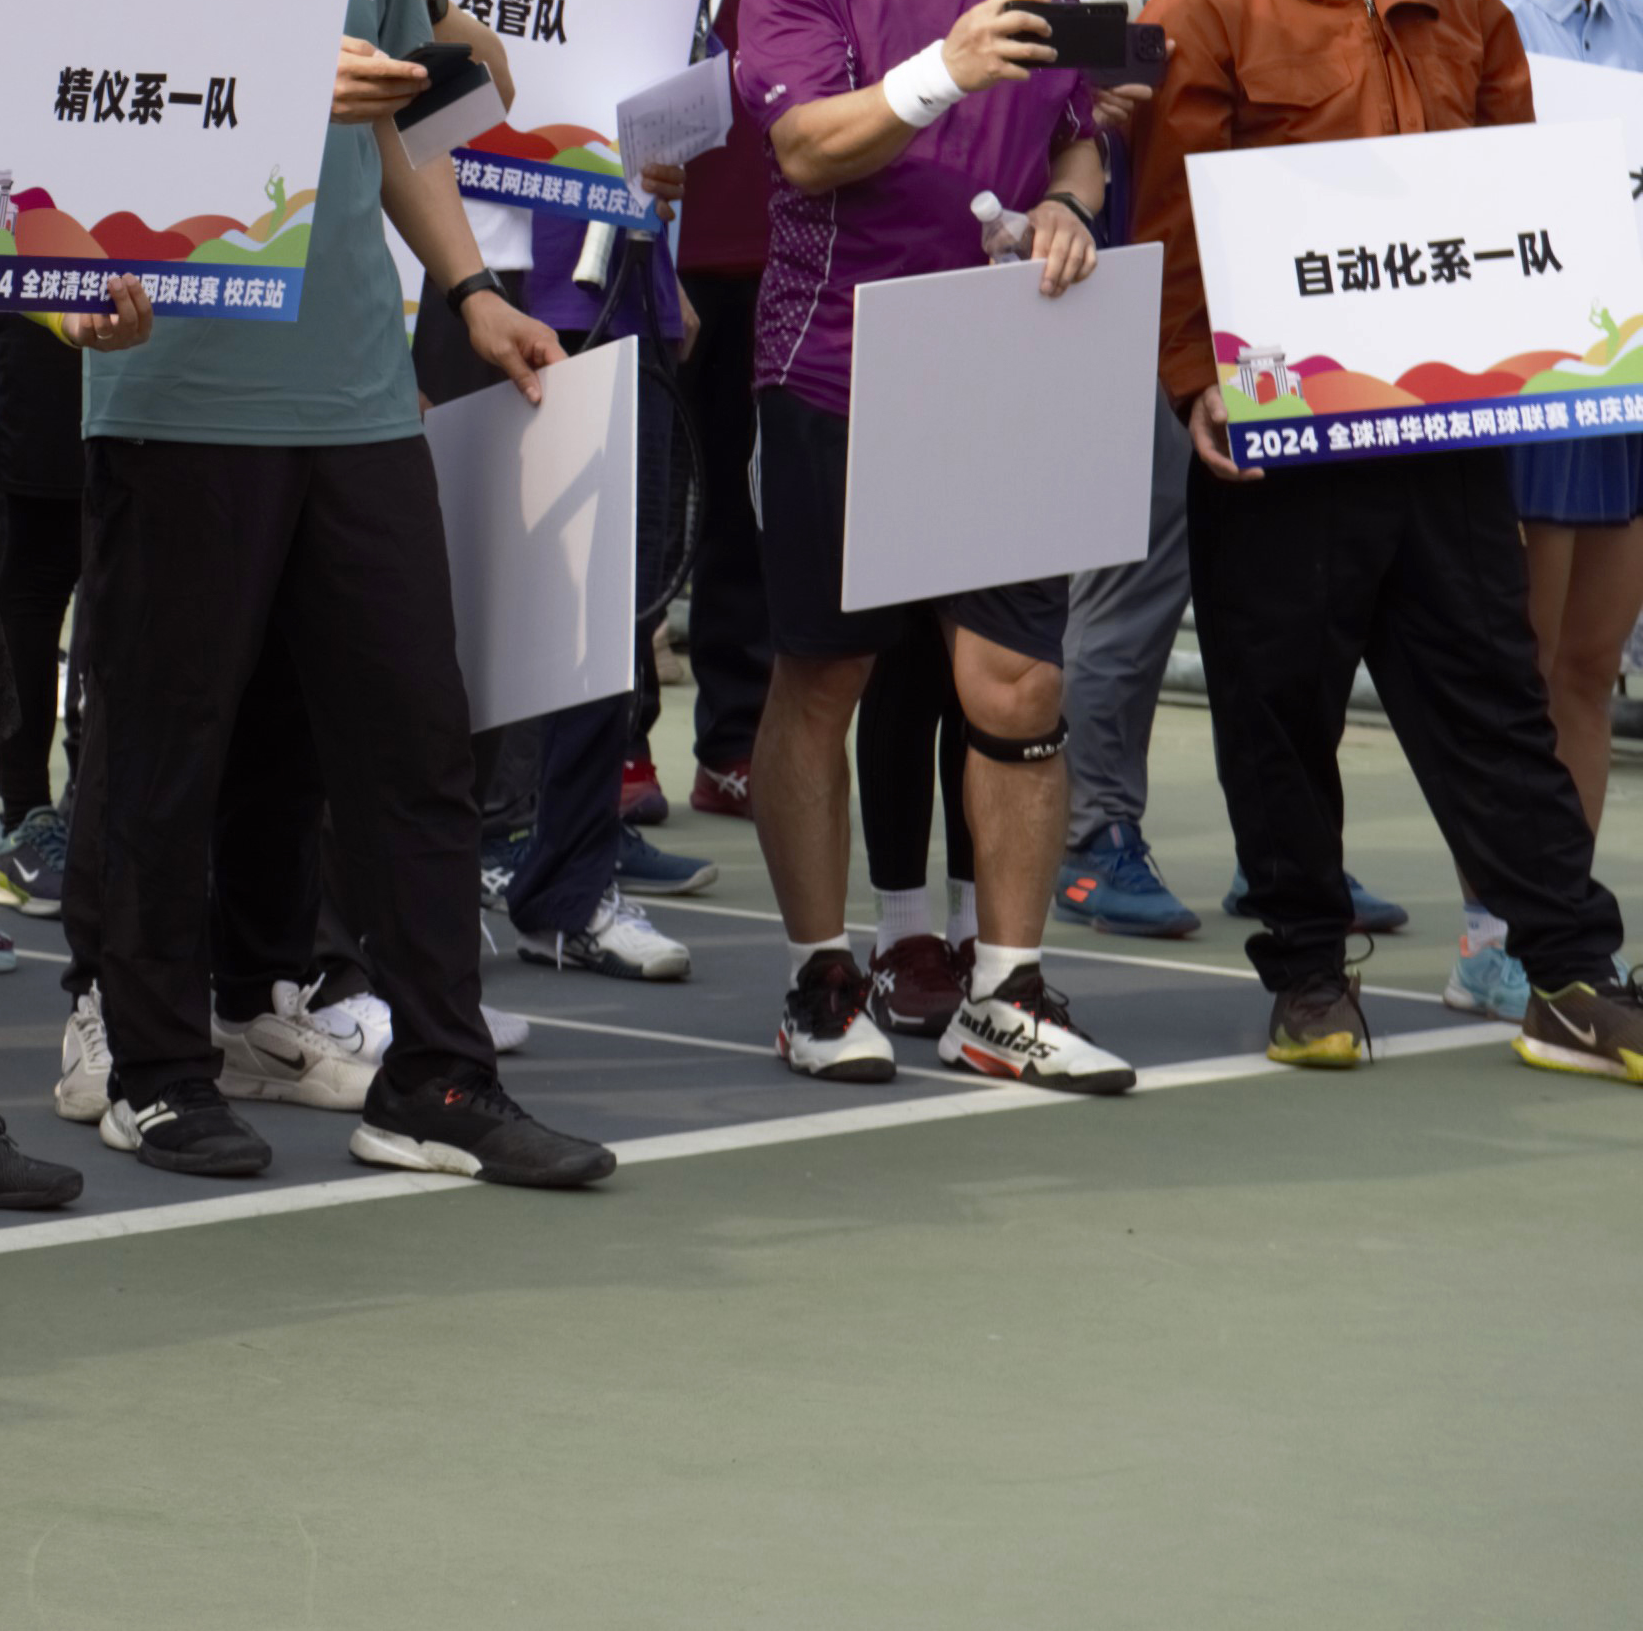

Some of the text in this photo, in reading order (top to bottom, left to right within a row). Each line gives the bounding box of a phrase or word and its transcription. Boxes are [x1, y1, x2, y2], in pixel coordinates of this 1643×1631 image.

[54, 66, 239, 130] 精仪系一队
[20, 270, 218, 306] 全球清华网球联赛
[224, 277, 284, 309] 校庆站
[1294, 229, 1564, 298] 自动化系一队
[1245, 393, 1643, 459] 2024 全球清华校友网球联赛 校庆站
